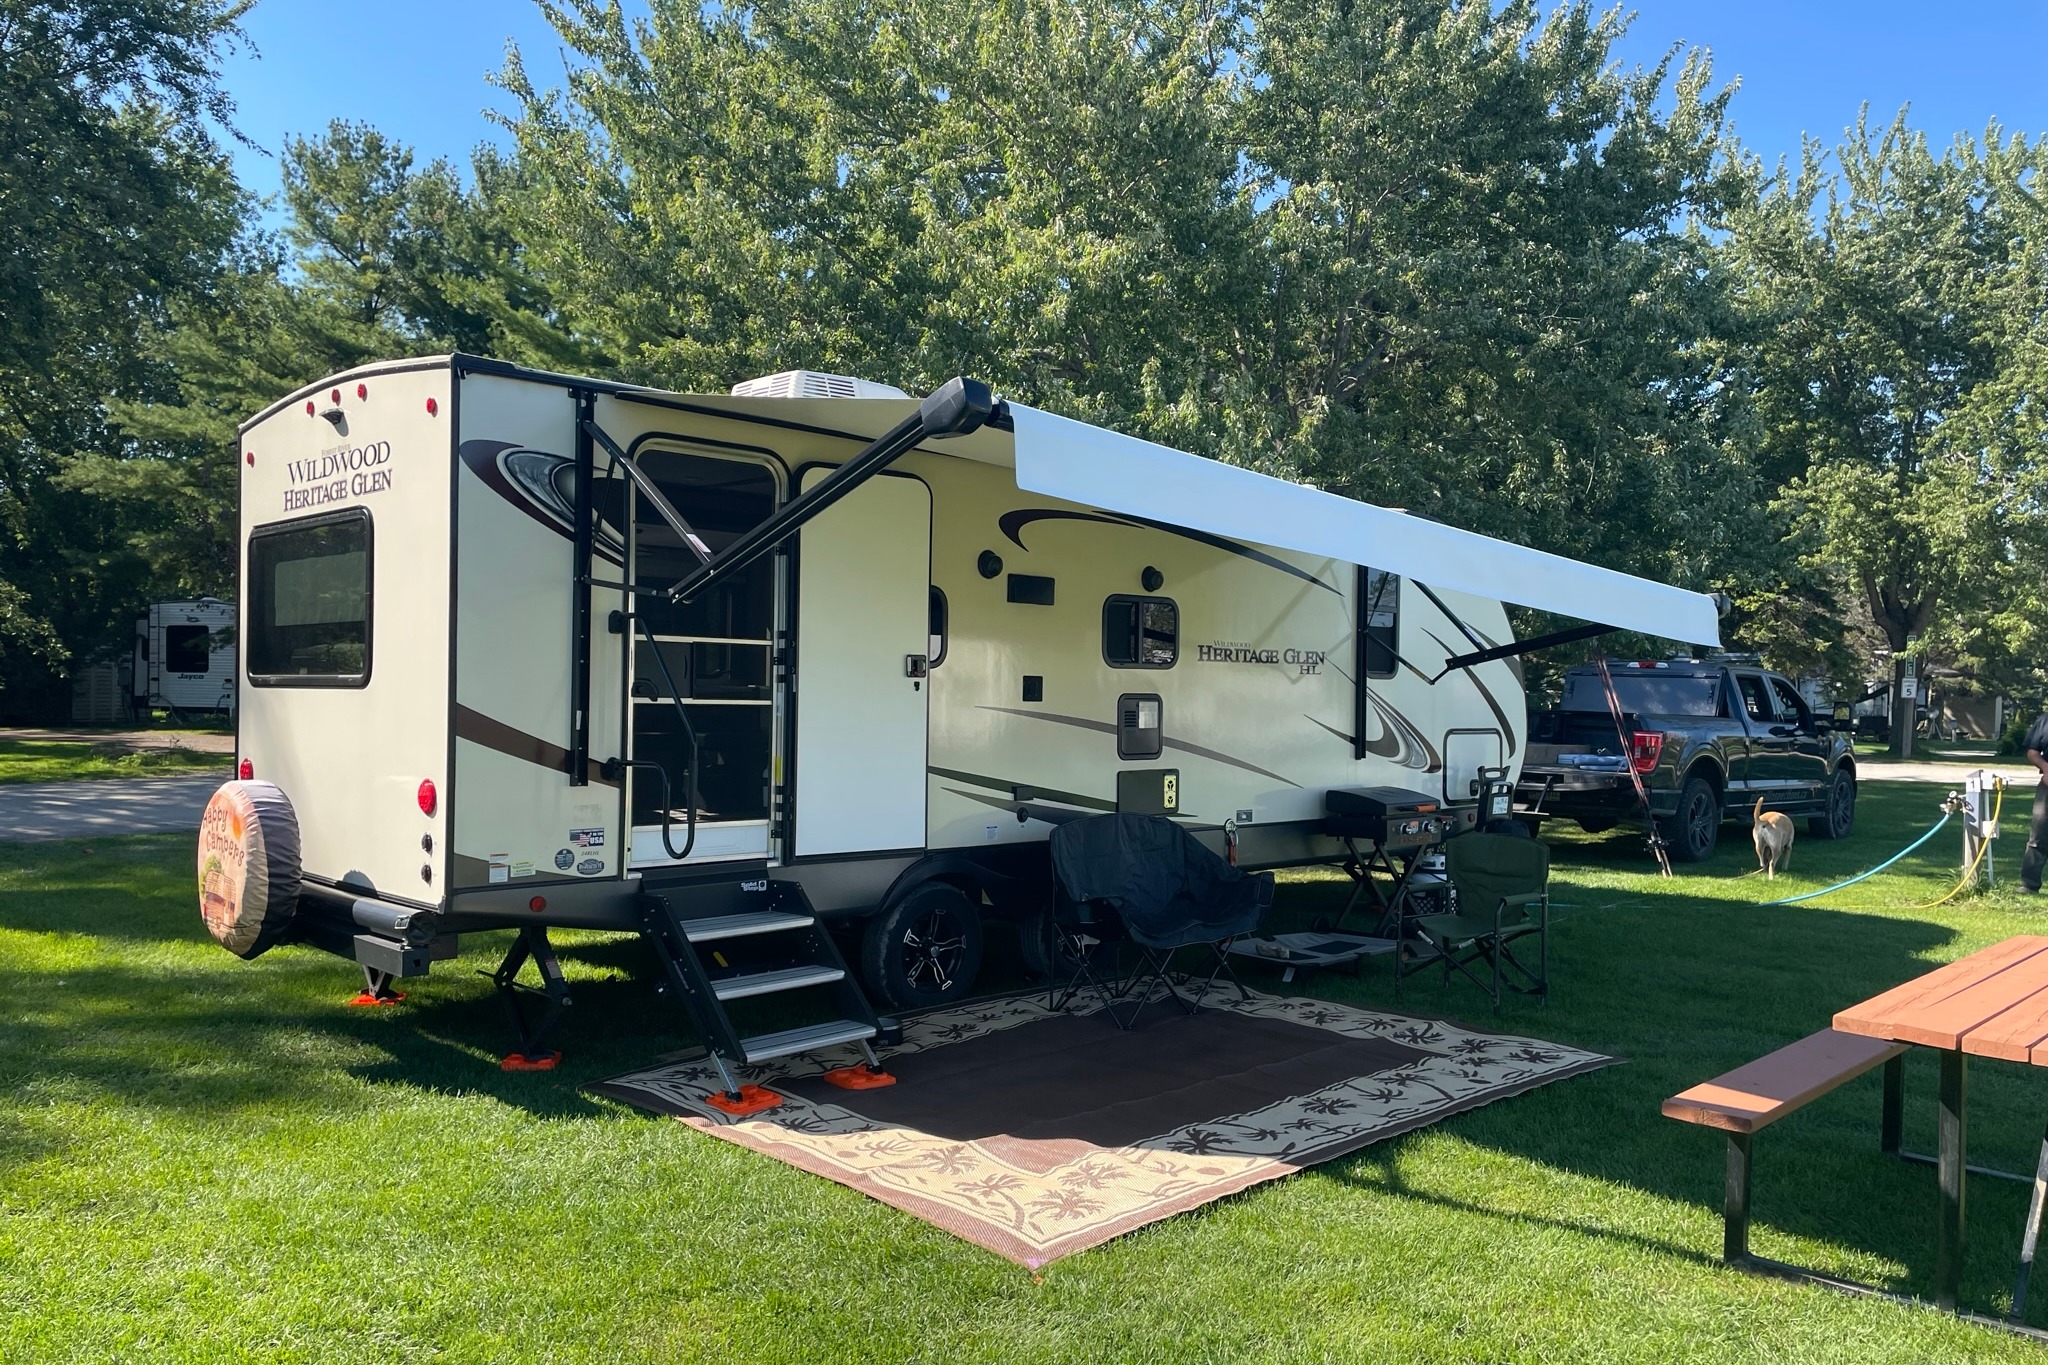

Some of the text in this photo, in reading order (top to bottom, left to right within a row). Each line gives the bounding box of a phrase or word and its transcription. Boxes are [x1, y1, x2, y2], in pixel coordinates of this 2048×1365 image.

[287, 440, 391, 485] WILDWOOD
[283, 468, 393, 512] HERITAGE GLEN
[1197, 644, 1326, 665] HERITAGE GLEN
[1299, 665, 1322, 675] HL
[1906, 688, 1912, 696] 5
[203, 807, 228, 832] Happy
[206, 831, 245, 867] Campers
[589, 836, 604, 844] USA
